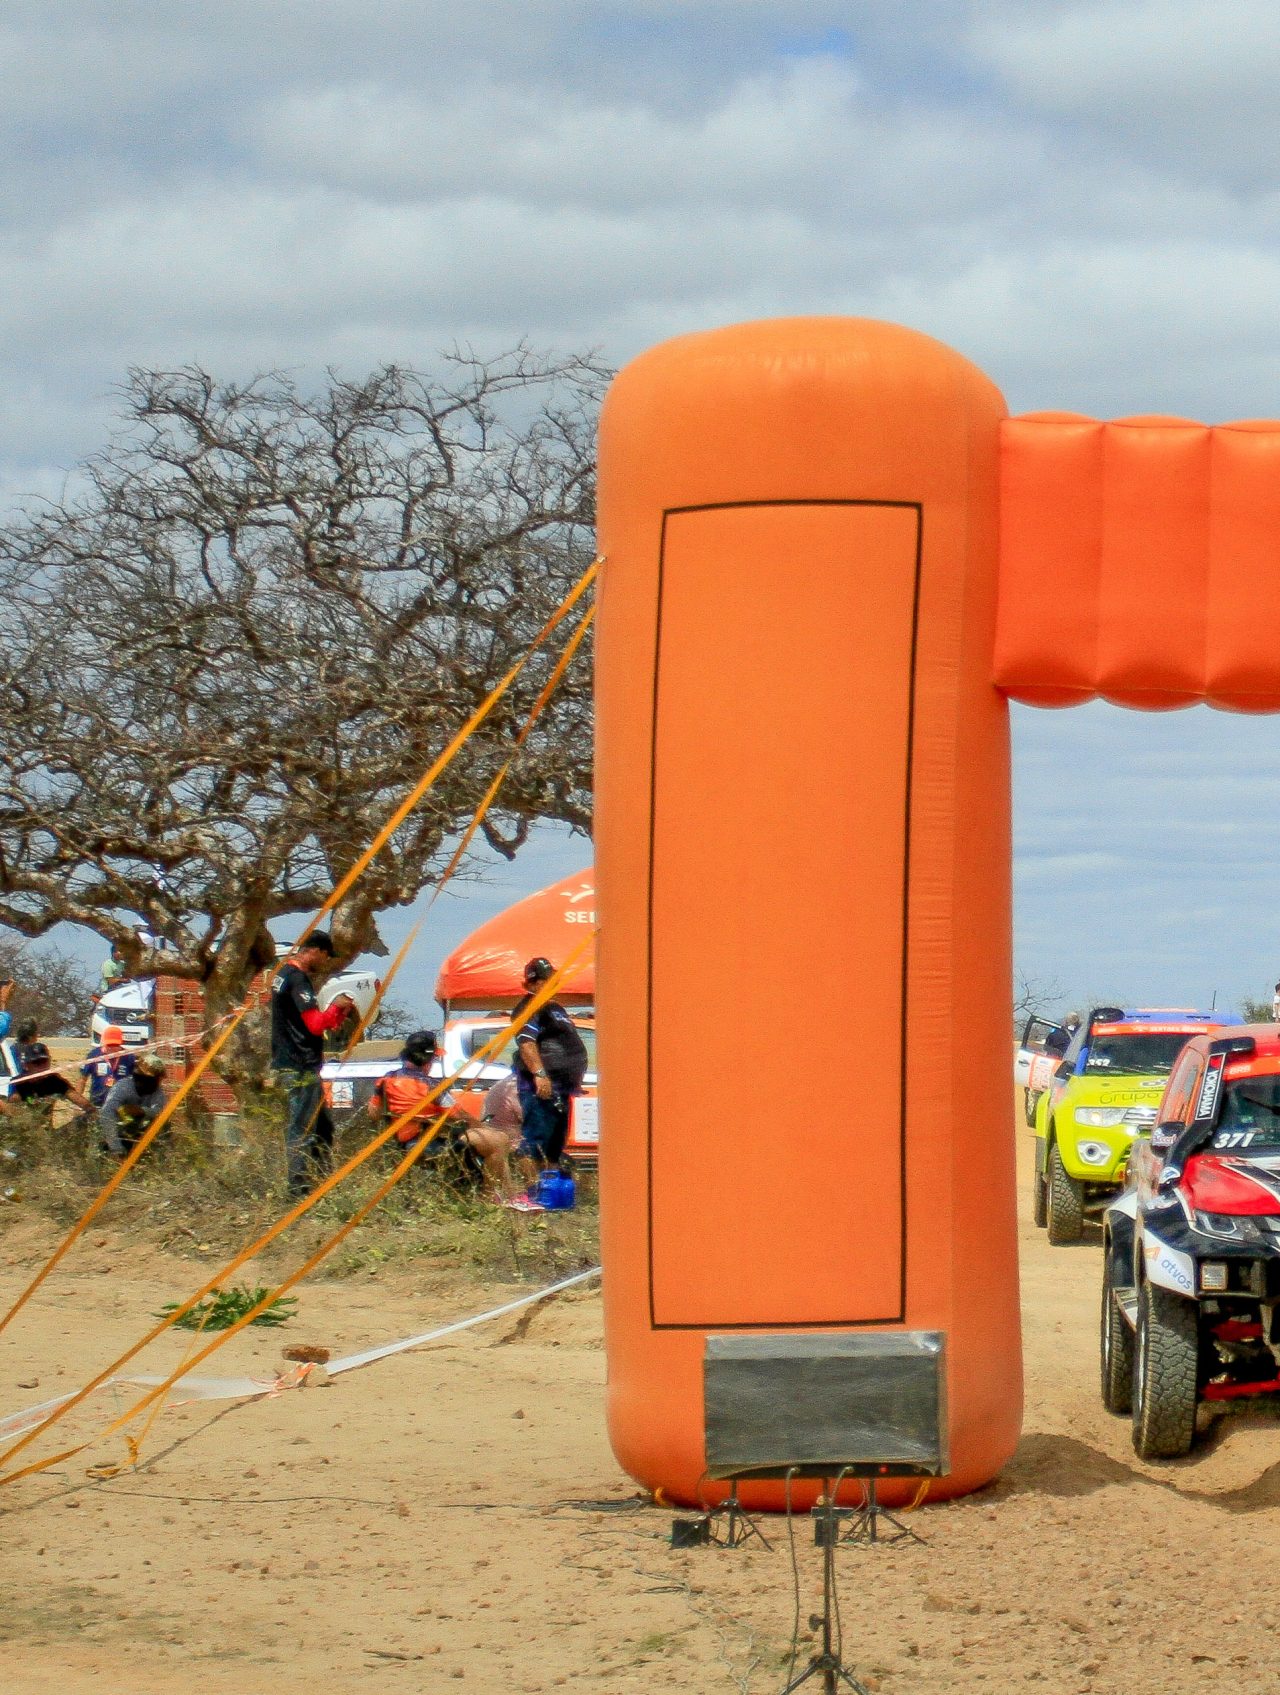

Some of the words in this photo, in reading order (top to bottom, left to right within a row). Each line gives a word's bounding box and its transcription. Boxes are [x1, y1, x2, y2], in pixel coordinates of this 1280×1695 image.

[1198, 1069, 1220, 1117] YOKOHAMA
[1214, 1132, 1255, 1148] 371
[1161, 1257, 1193, 1290] atvos
